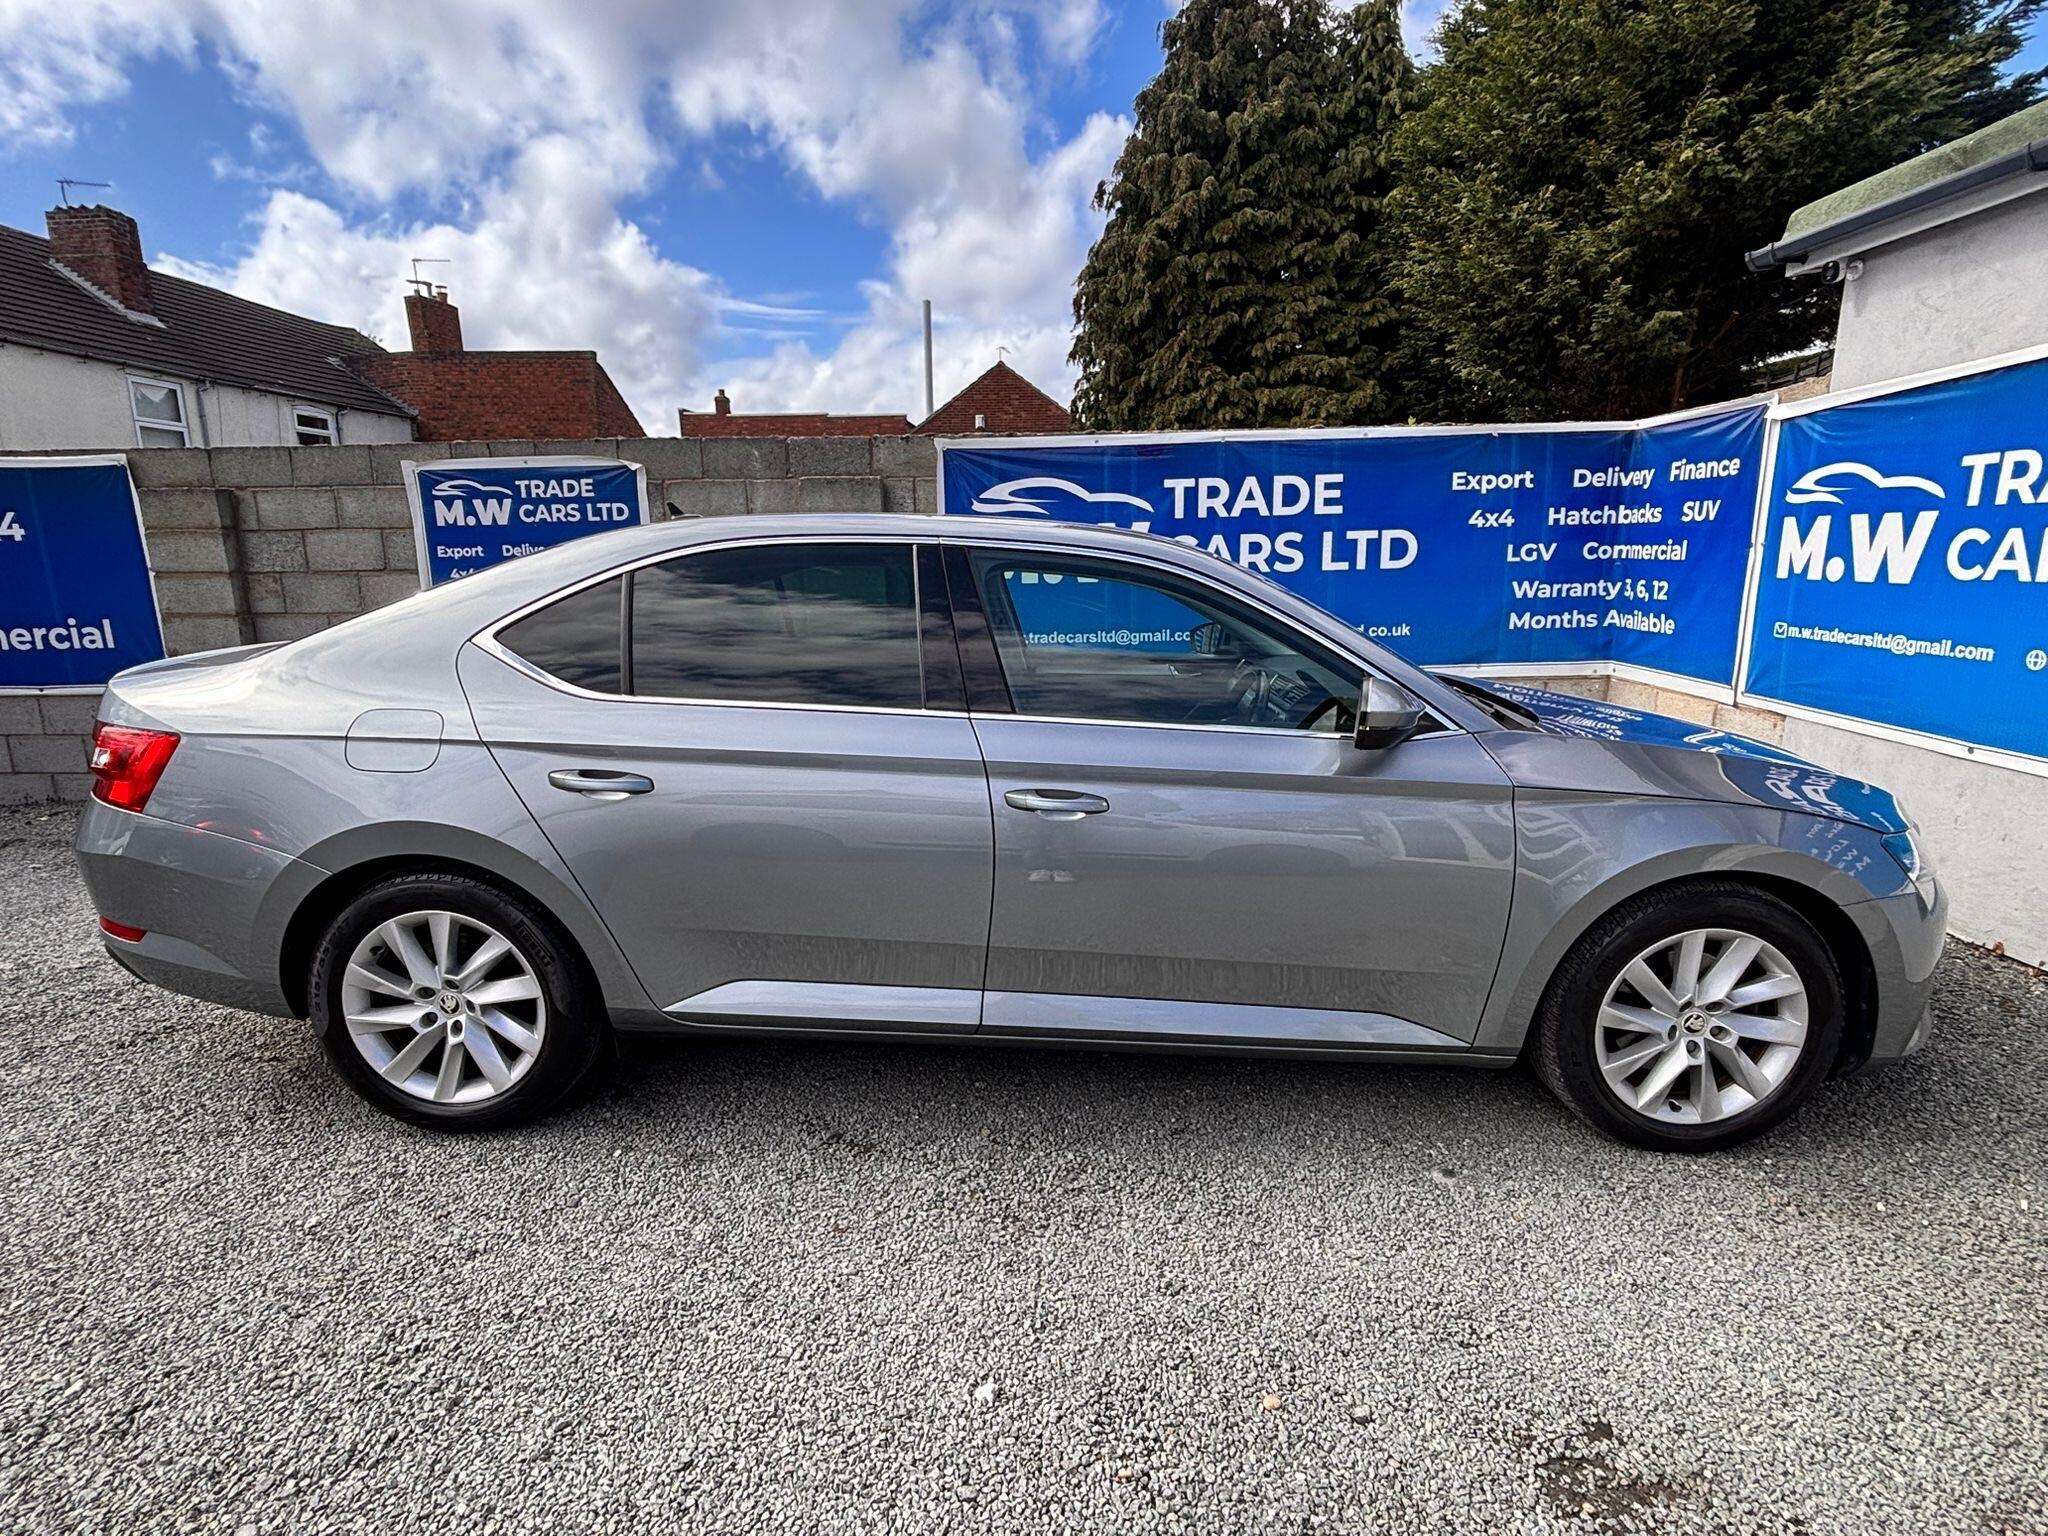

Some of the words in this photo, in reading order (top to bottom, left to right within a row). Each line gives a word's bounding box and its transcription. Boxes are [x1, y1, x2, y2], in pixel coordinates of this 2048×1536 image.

[515, 478, 594, 498] TRADE
[1452, 471, 1535, 494] Export
[1573, 466, 1656, 490] Delivery
[1669, 457, 1741, 482] Finance
[1164, 474, 1344, 519] TRADE
[0, 511, 26, 541] 4
[434, 498, 512, 527] M.W
[518, 503, 581, 523] CARS
[587, 502, 630, 522] LTD
[1468, 508, 1515, 528] 4x4
[1548, 503, 1663, 526] Hatchbacks
[1681, 499, 1722, 522] SUV
[437, 545, 485, 560] Export
[1321, 529, 1419, 571] LTD
[1506, 542, 1558, 562] LGV
[1582, 539, 1688, 561] Commercial
[1776, 510, 1939, 585] M.W
[1512, 580, 1622, 601] Warranty
[1624, 579, 1634, 601] 3,
[1636, 579, 1650, 602] 6,
[1652, 580, 1669, 601] 12
[1508, 609, 1598, 630] Months
[1602, 609, 1676, 635] Available
[1787, 625, 1995, 662] m.w.tradecarsltd@gmail.com
